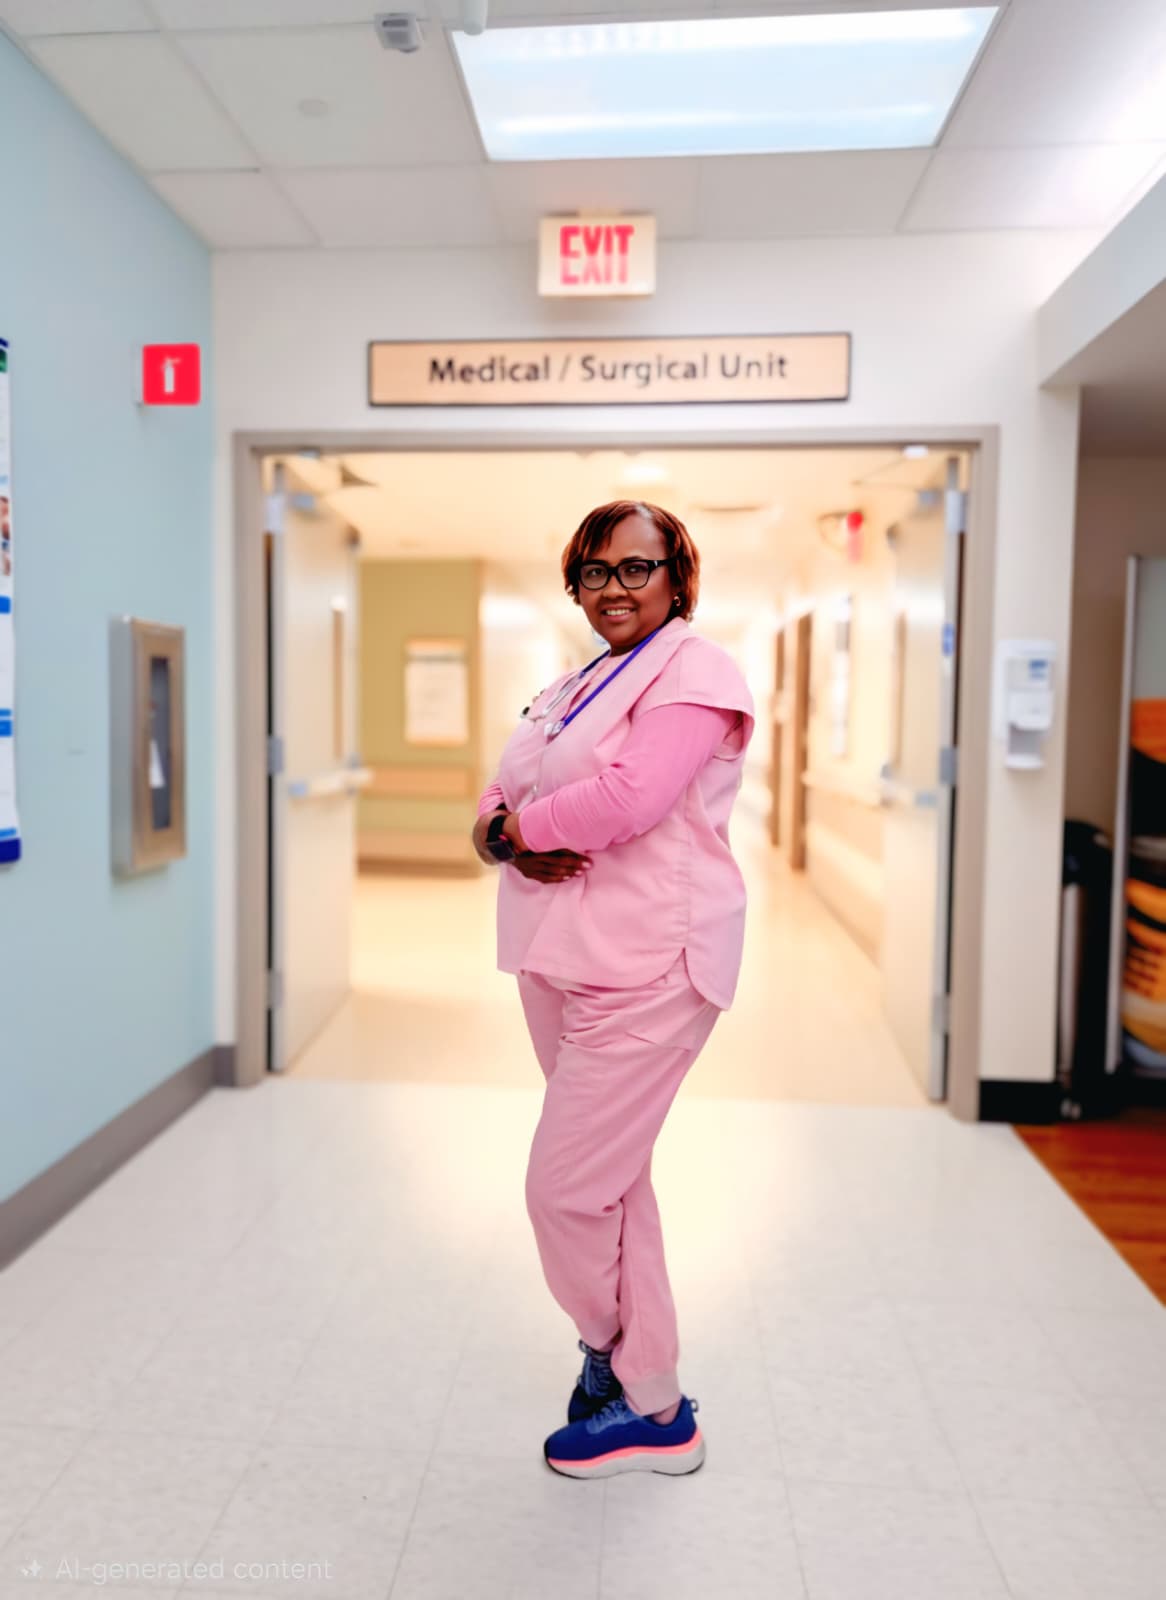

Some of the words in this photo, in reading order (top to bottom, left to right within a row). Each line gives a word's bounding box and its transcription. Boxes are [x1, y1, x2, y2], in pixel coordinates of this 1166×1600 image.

[560, 224, 635, 285] EXIT
[429, 354, 550, 383] Medical
[559, 353, 573, 383] /
[581, 352, 708, 389] Surgical
[719, 351, 788, 379] Unit
